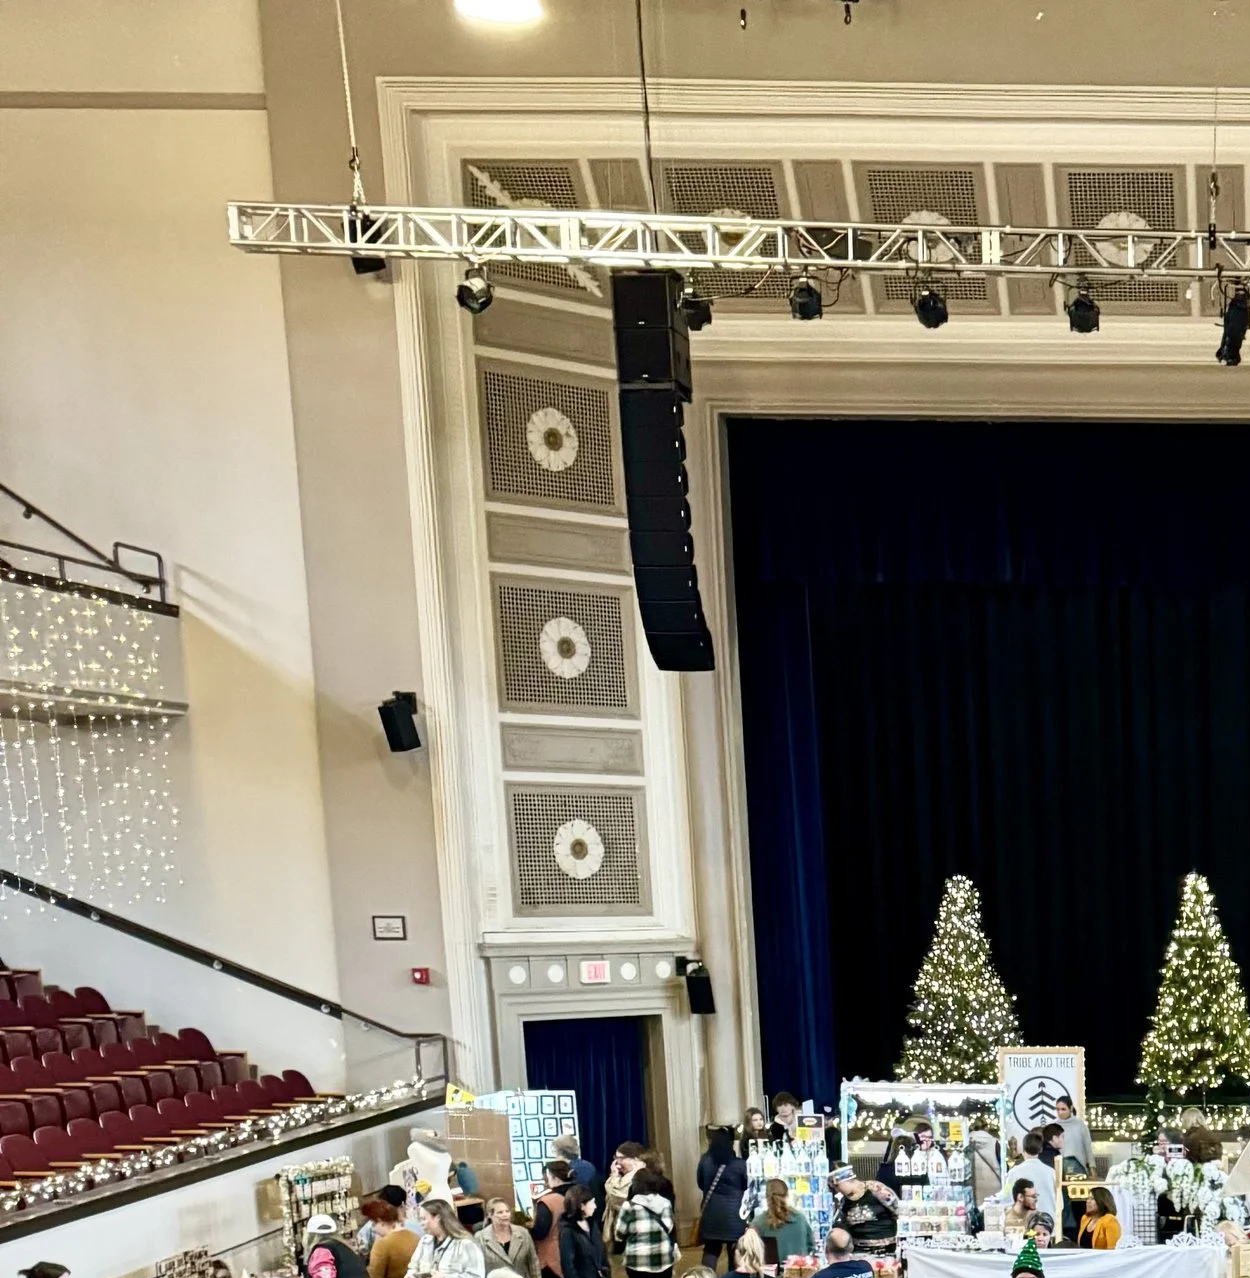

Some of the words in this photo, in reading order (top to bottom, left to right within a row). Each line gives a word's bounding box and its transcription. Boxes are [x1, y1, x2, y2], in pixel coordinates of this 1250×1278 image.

[1008, 1056, 1032, 1068] TRIBE
[1034, 1056, 1053, 1068] AND
[1055, 1057, 1076, 1068] TREE
